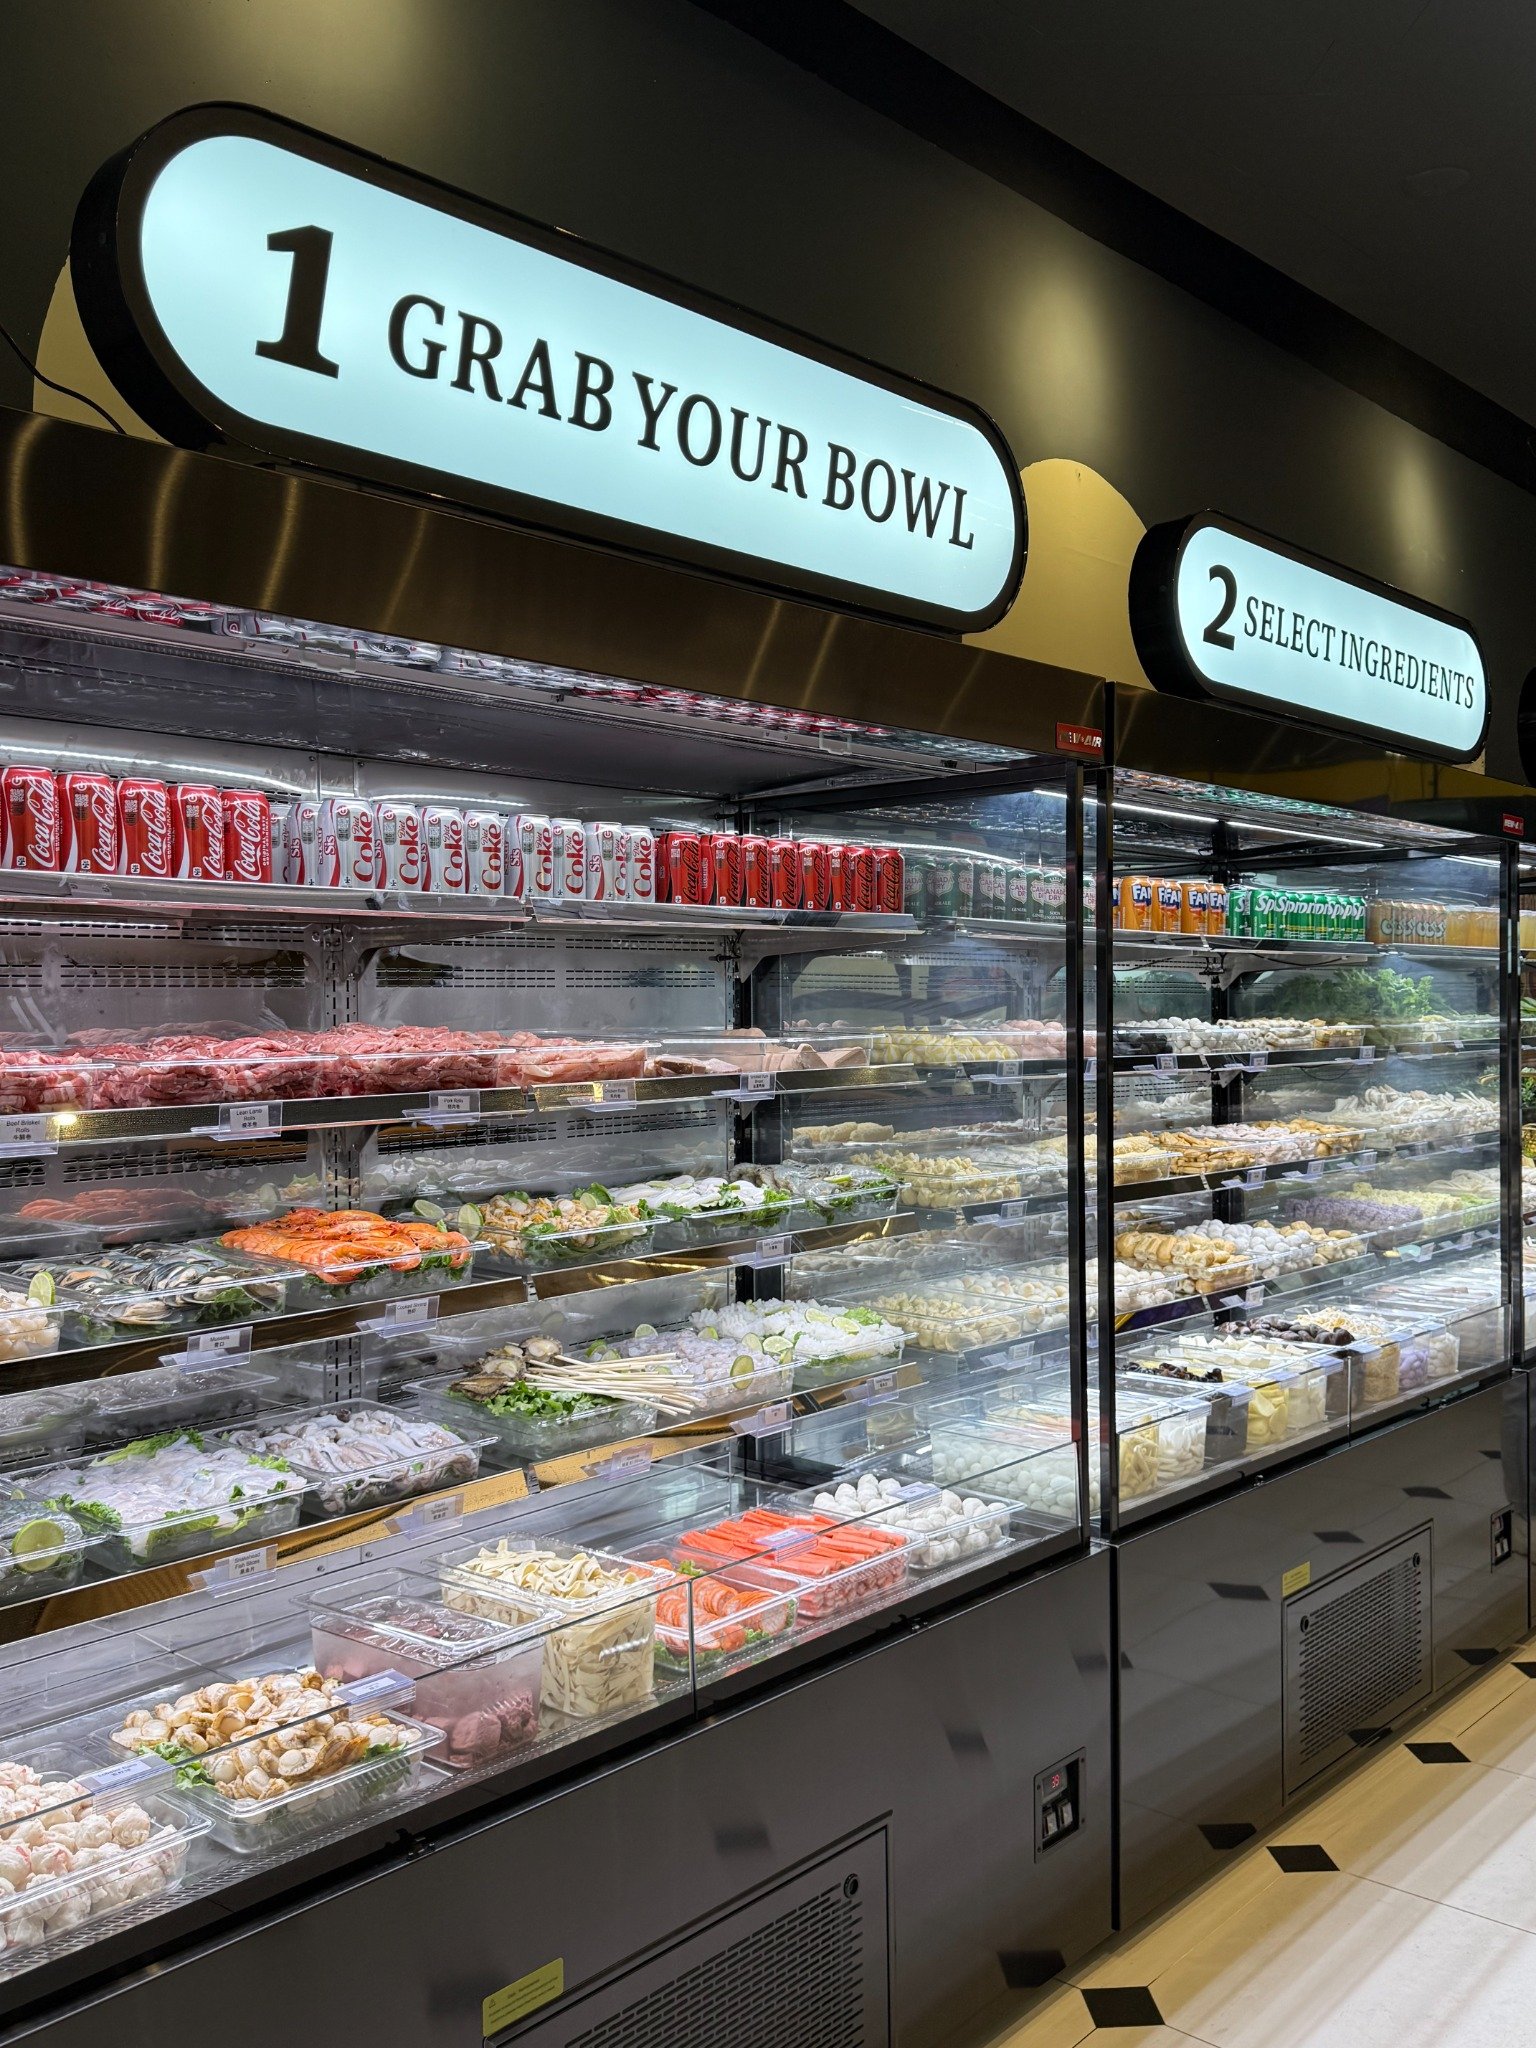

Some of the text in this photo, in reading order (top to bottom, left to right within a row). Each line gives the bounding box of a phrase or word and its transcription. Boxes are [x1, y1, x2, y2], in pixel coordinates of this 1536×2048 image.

[255, 224, 975, 550] 1 GRAB YOUR BOWL
[1202, 564, 1475, 710] 2 SELECT INGREDIENTS
[324, 834, 336, 856] Sis
[353, 811, 374, 882] Coke
[399, 815, 420, 885] Coke
[443, 820, 463, 888] Coke
[481, 823, 502, 890] Coke
[535, 827, 552, 892] Coke
[565, 830, 584, 894] Coke
[633, 836, 652, 897] Coke
[1048, 894, 1062, 902] DRY
